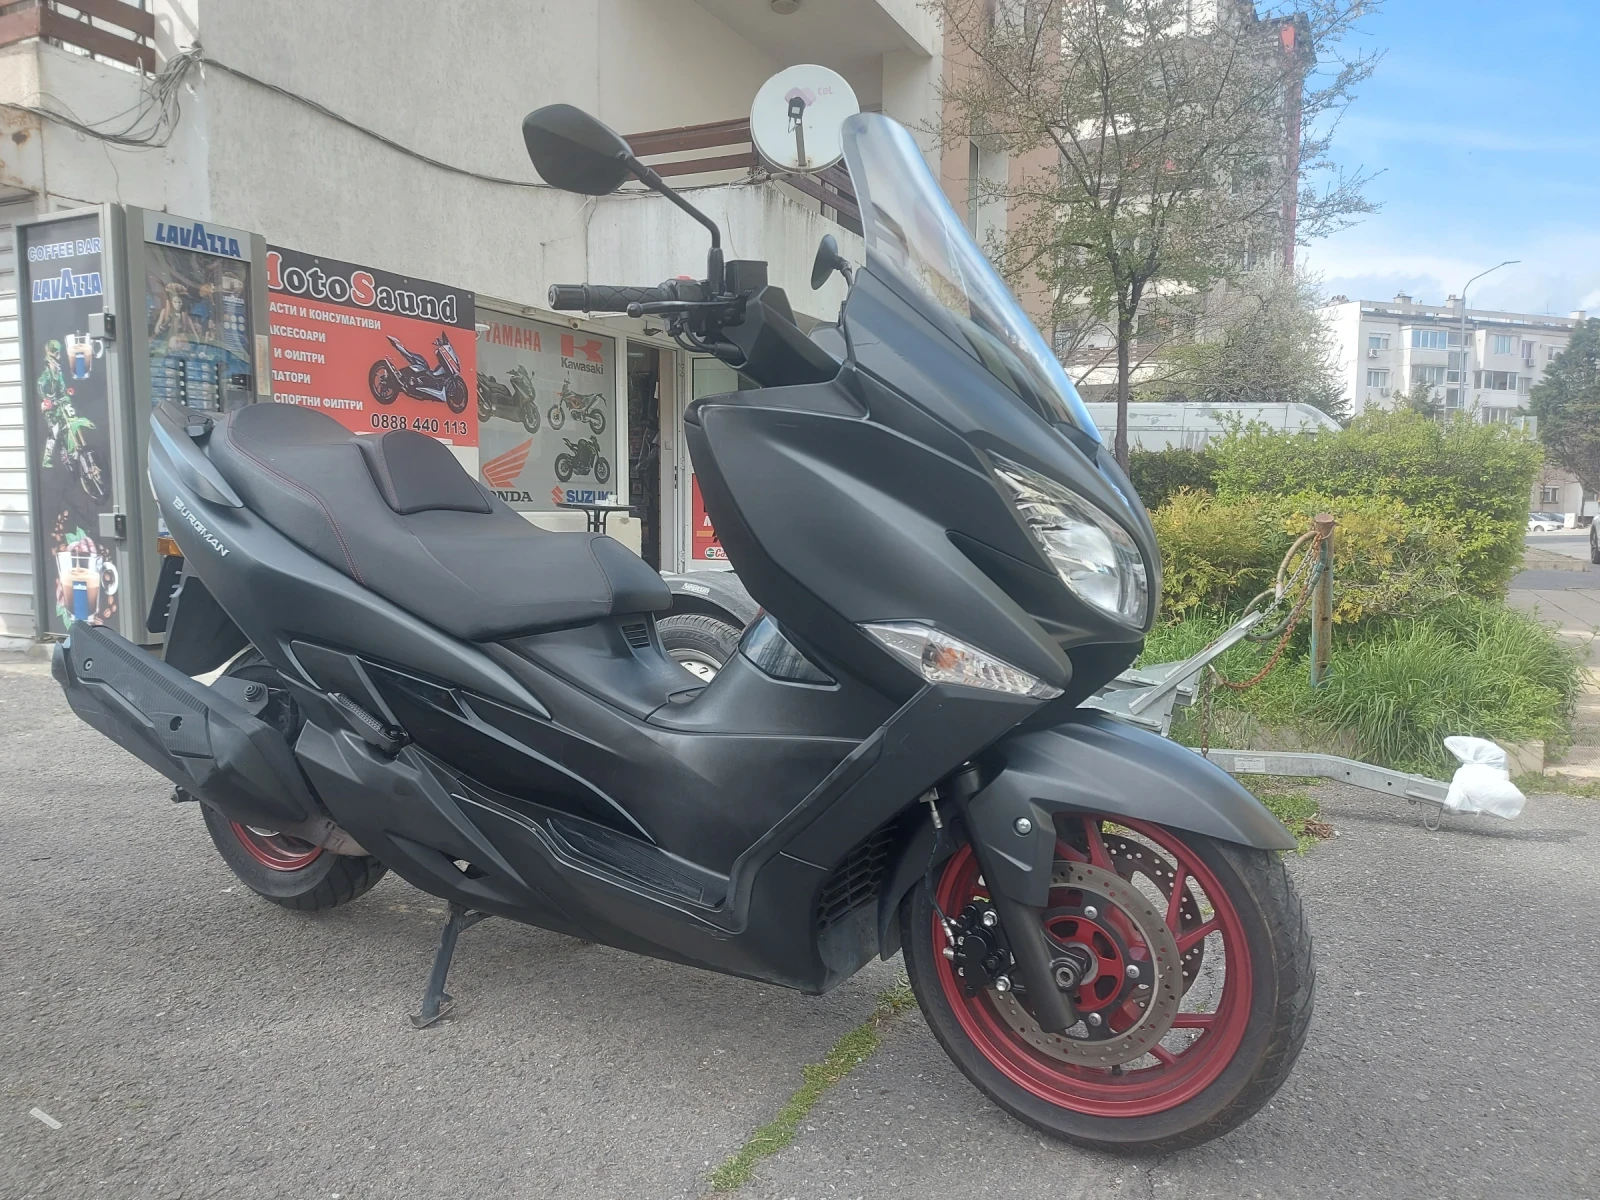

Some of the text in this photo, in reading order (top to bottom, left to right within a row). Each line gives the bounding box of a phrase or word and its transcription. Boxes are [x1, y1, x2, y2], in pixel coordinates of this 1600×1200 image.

[28, 237, 102, 262] COFFEE BAR
[155, 222, 242, 259] LAVAZZA
[32, 268, 103, 302] LAVAZZA
[299, 307, 307, 317] И
[309, 308, 381, 330] КОНСУМАТИВИ
[484, 321, 542, 352] YAMAHA
[274, 348, 325, 364] И ФИЛТРИ
[560, 356, 604, 375] Kawasaki
[273, 392, 363, 410] СПОРТНИ ФИЛТРИ
[371, 412, 468, 436] 0888 440 113
[490, 490, 533, 502] NDA
[172, 495, 231, 557] BURGMAN
